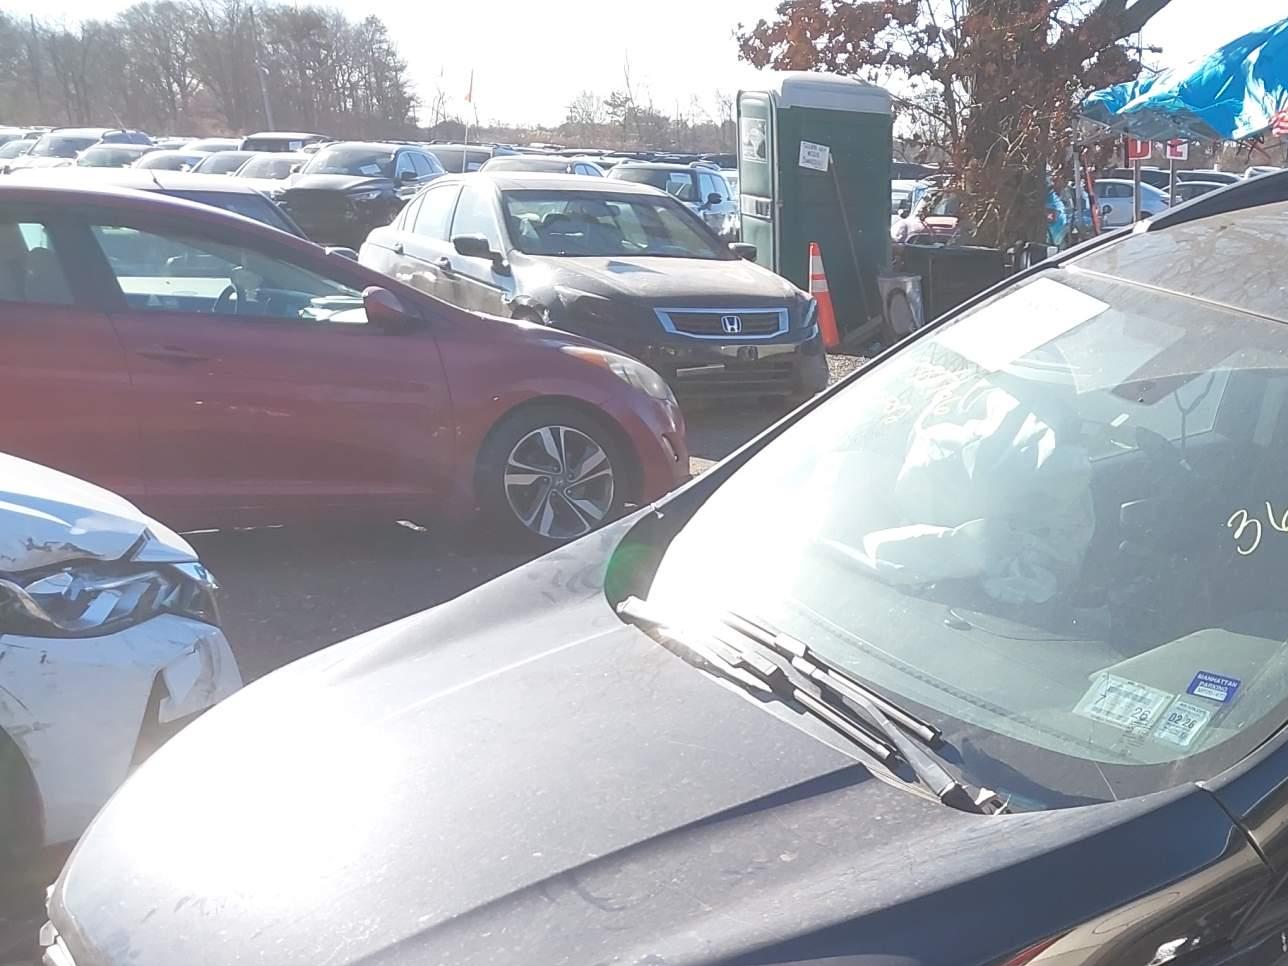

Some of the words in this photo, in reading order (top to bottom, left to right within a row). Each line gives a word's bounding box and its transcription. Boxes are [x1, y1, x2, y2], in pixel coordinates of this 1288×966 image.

[1197, 673, 1239, 687] MANHATTAN
[1168, 712, 1183, 723] 02
[1182, 717, 1197, 730] 26
